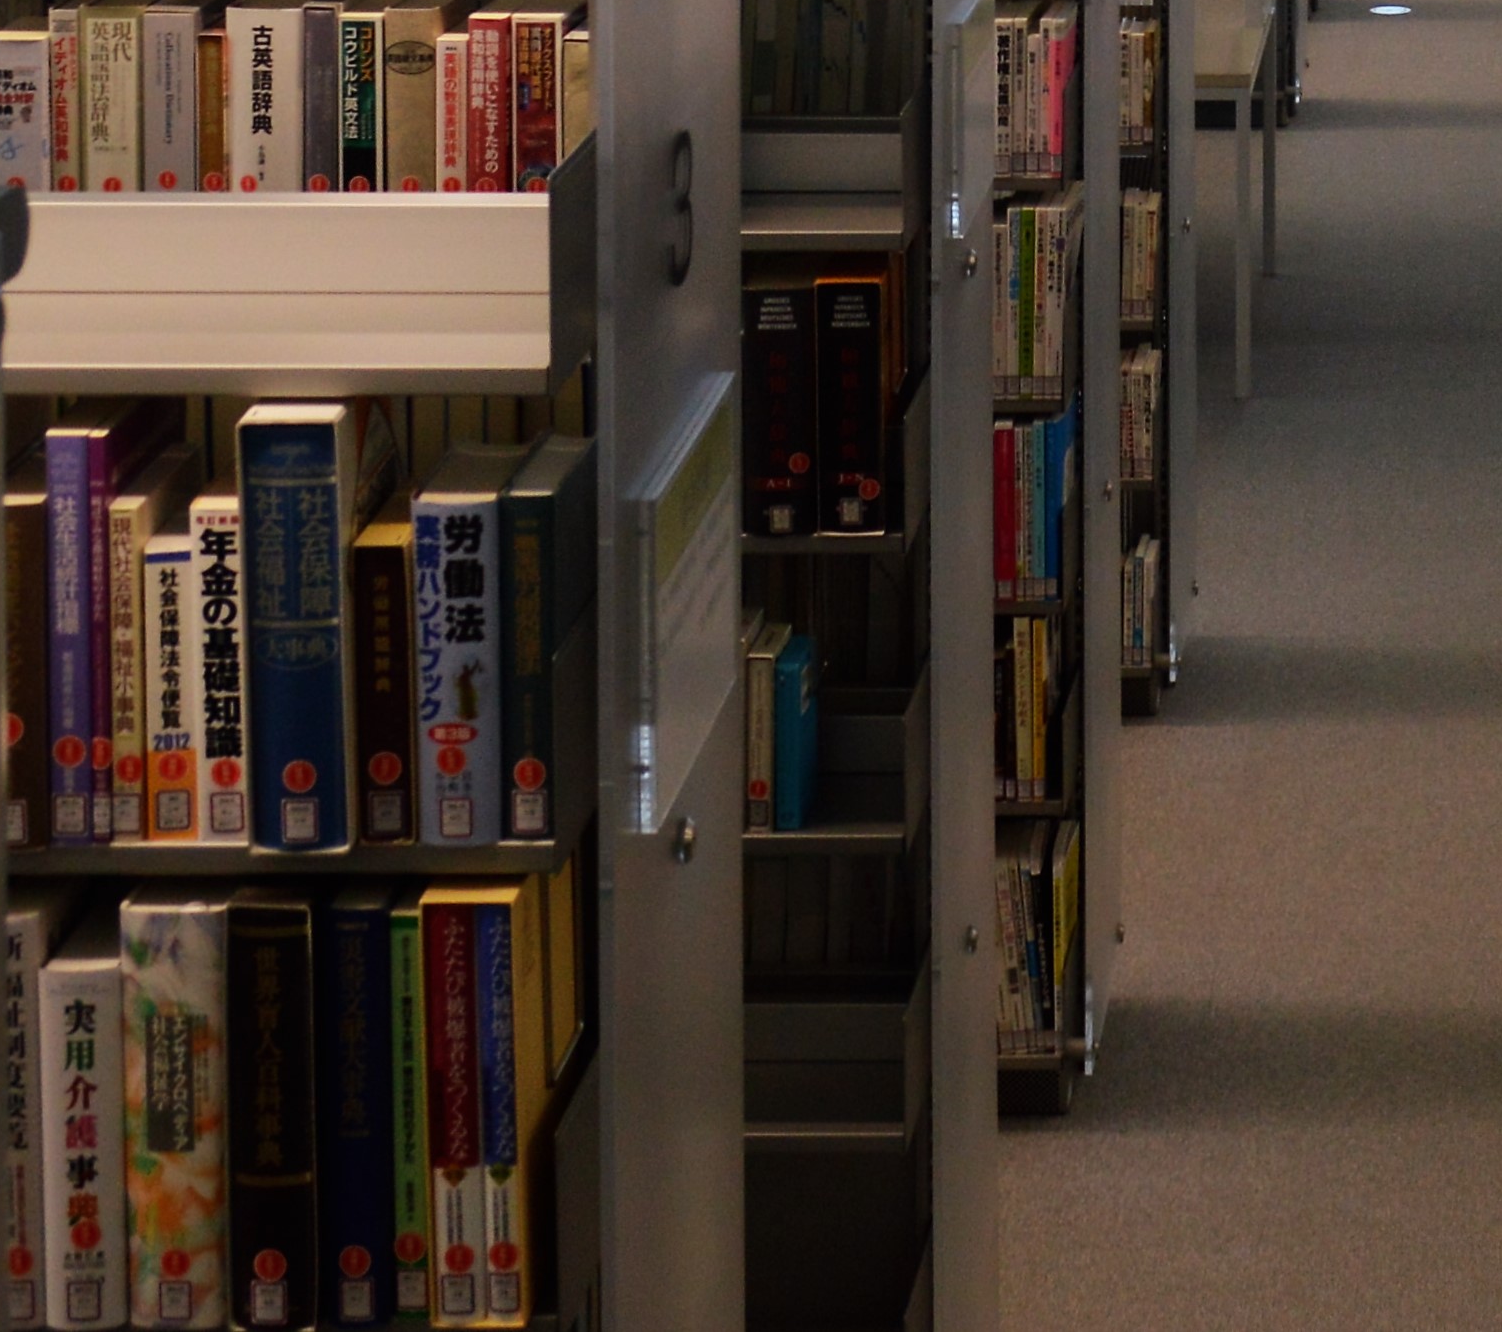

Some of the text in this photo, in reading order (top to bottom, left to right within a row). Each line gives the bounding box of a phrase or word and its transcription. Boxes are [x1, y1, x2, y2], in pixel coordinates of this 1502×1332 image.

[112, 21, 132, 62] 現代
[252, 25, 273, 135] 古英語辞典
[255, 489, 286, 616] 社会福祉
[298, 489, 331, 617] 社会保障
[444, 515, 485, 644] 労働法
[112, 519, 135, 734] 現代社会保障・福祉小事典
[159, 568, 181, 729] 社会保障法令便覧
[200, 529, 242, 758] 年金の基礎知識
[267, 637, 327, 659] 大事典
[416, 515, 443, 723] 実務ハンドブック
[153, 733, 190, 751] 2012
[64, 998, 99, 1229] 実用介護事典
[169, 1015, 189, 1152] エンサイクロペディア
